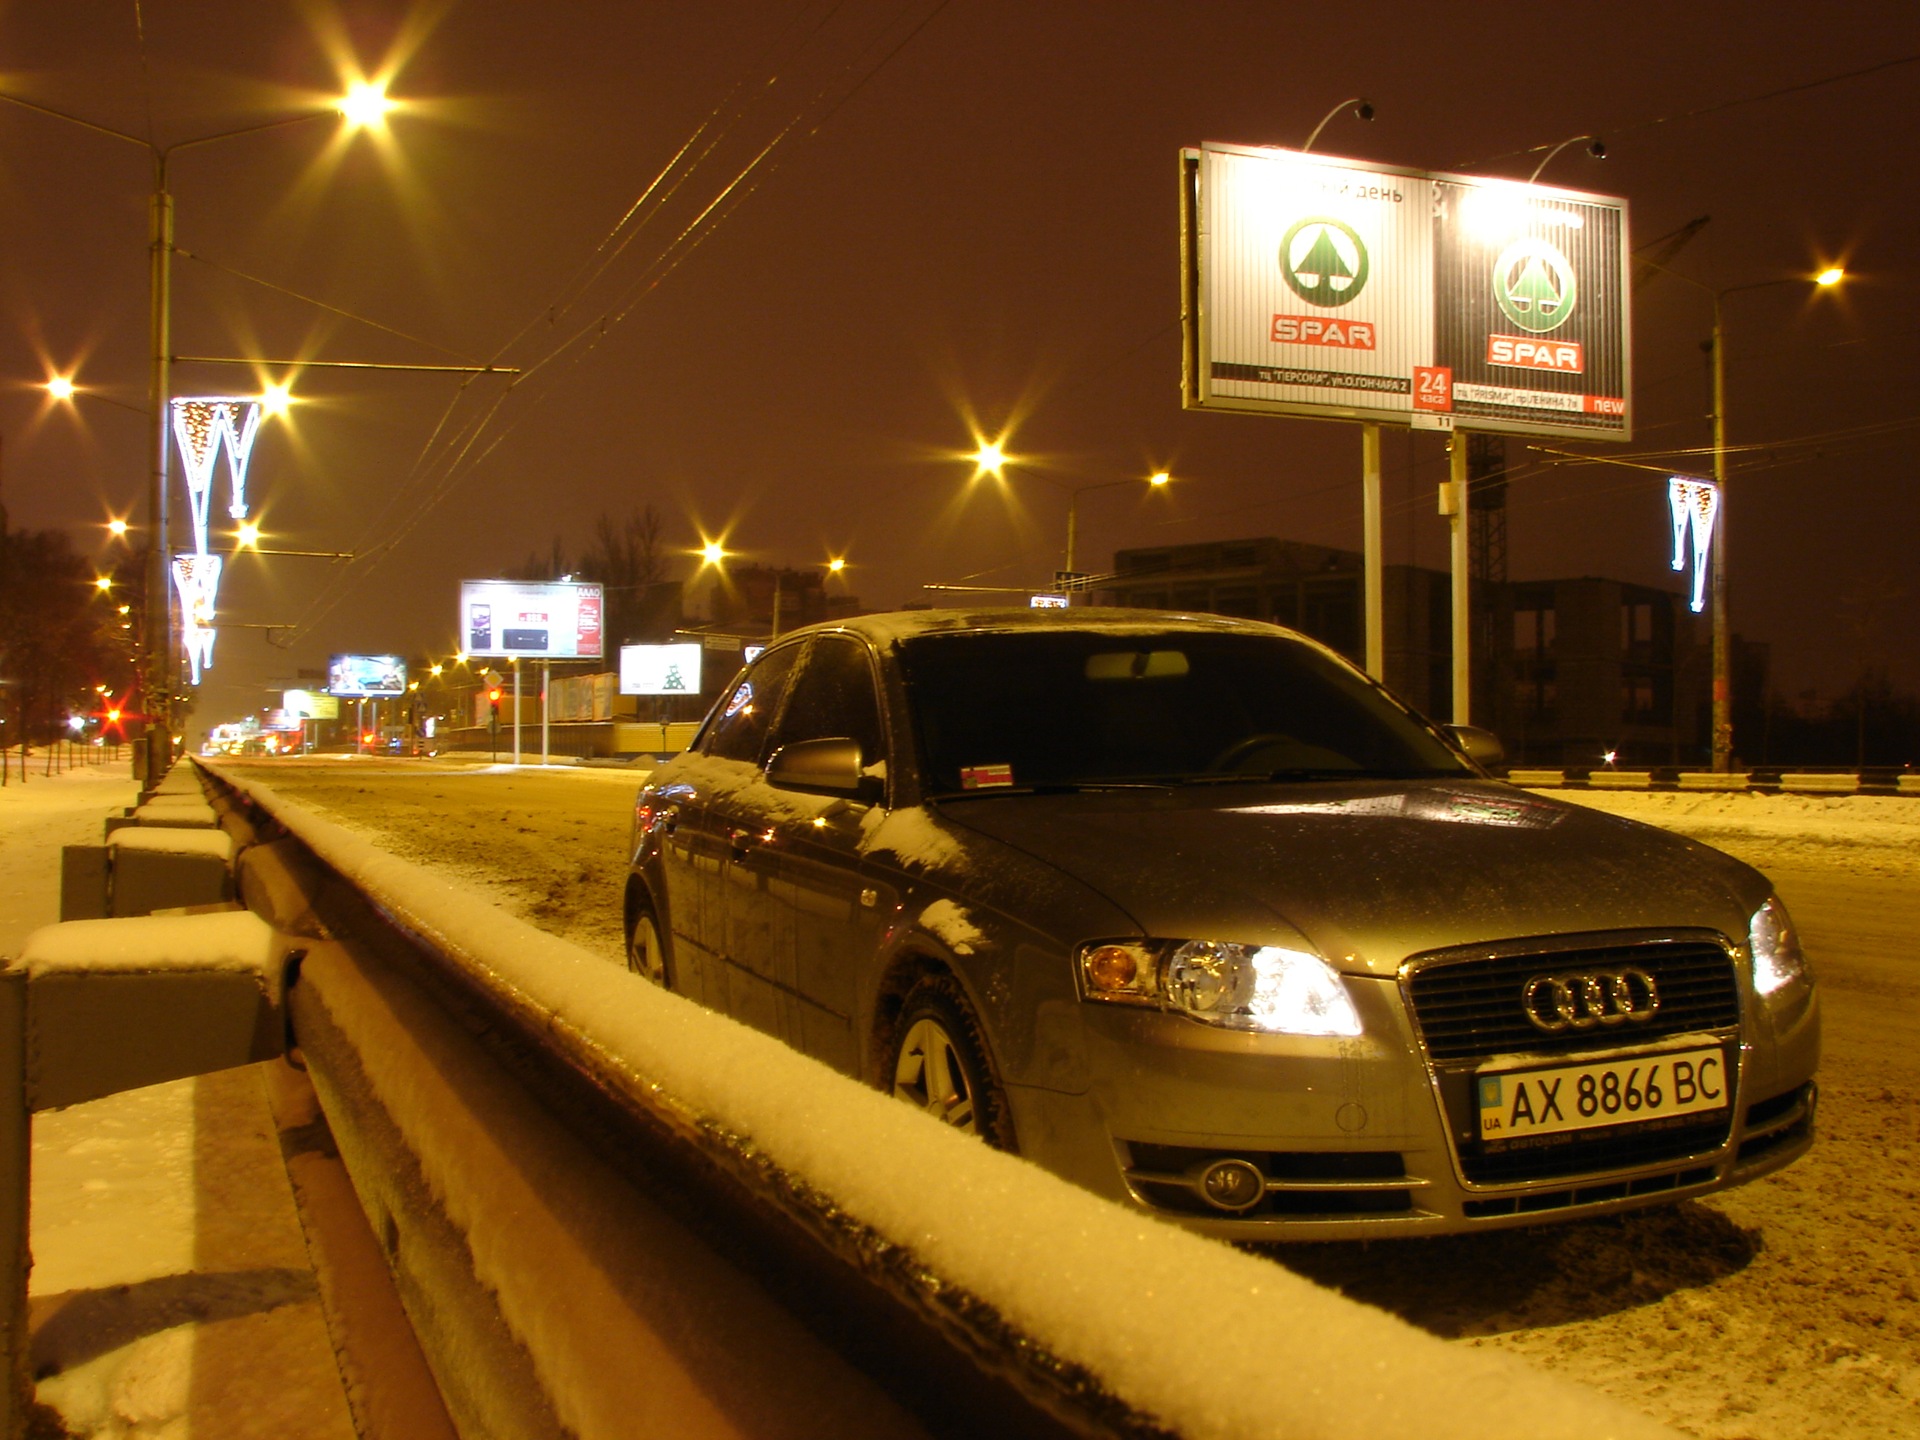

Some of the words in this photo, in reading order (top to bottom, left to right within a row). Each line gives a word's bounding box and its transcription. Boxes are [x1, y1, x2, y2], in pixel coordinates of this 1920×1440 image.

[1357, 186, 1403, 203] день
[1274, 318, 1372, 347] SPAR
[1492, 341, 1577, 369] SPAR
[1420, 372, 1447, 395] 24
[1420, 394, 1446, 405] часа
[1594, 400, 1624, 413] new
[1437, 417, 1450, 427] 11
[1510, 1077, 1564, 1128] AX
[1577, 1065, 1663, 1118] 8866
[1673, 1057, 1721, 1105] BC
[1483, 1117, 1502, 1131] UA
